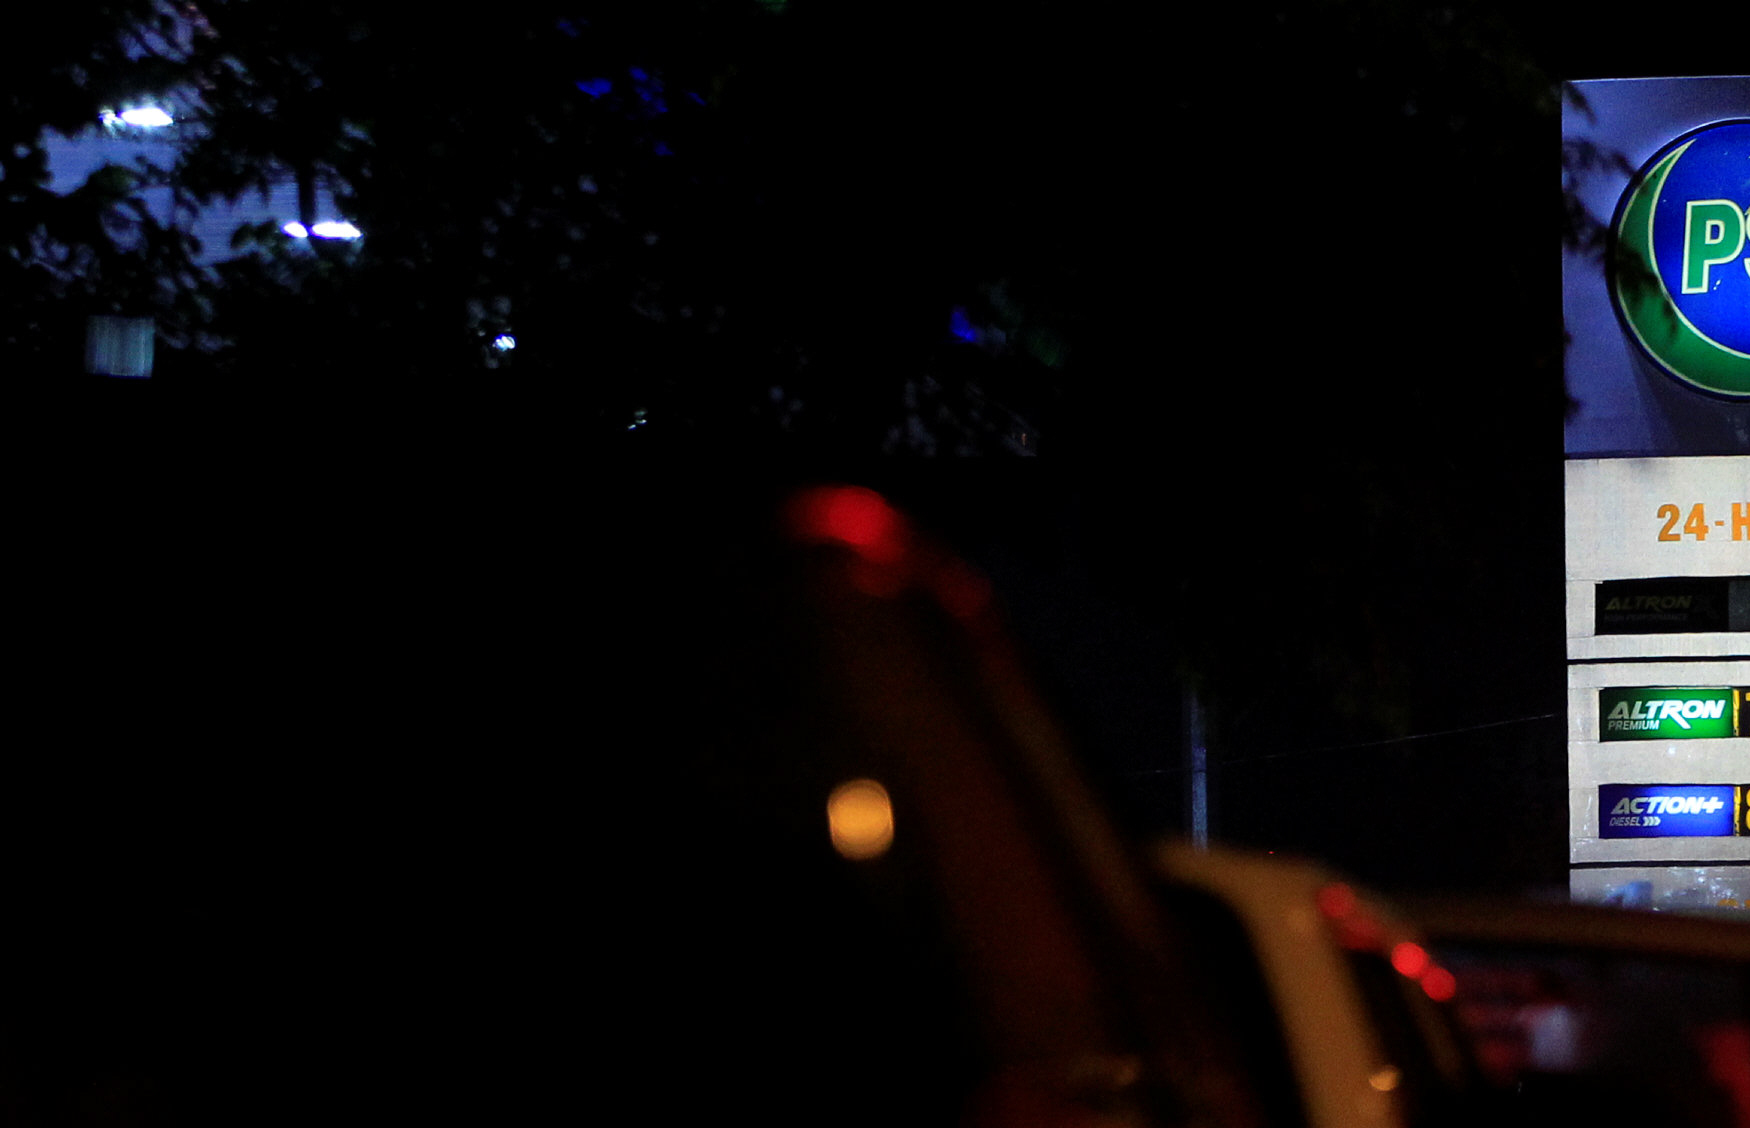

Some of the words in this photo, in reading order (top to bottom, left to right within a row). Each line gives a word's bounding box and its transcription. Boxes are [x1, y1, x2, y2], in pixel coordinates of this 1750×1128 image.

[1604, 595, 1693, 613] ALTRON
[1607, 699, 1727, 730] ALTRON
[1608, 719, 1660, 731] PREMIUM
[1609, 795, 1724, 815] ACTION+
[1608, 816, 1642, 827] DIESEL
